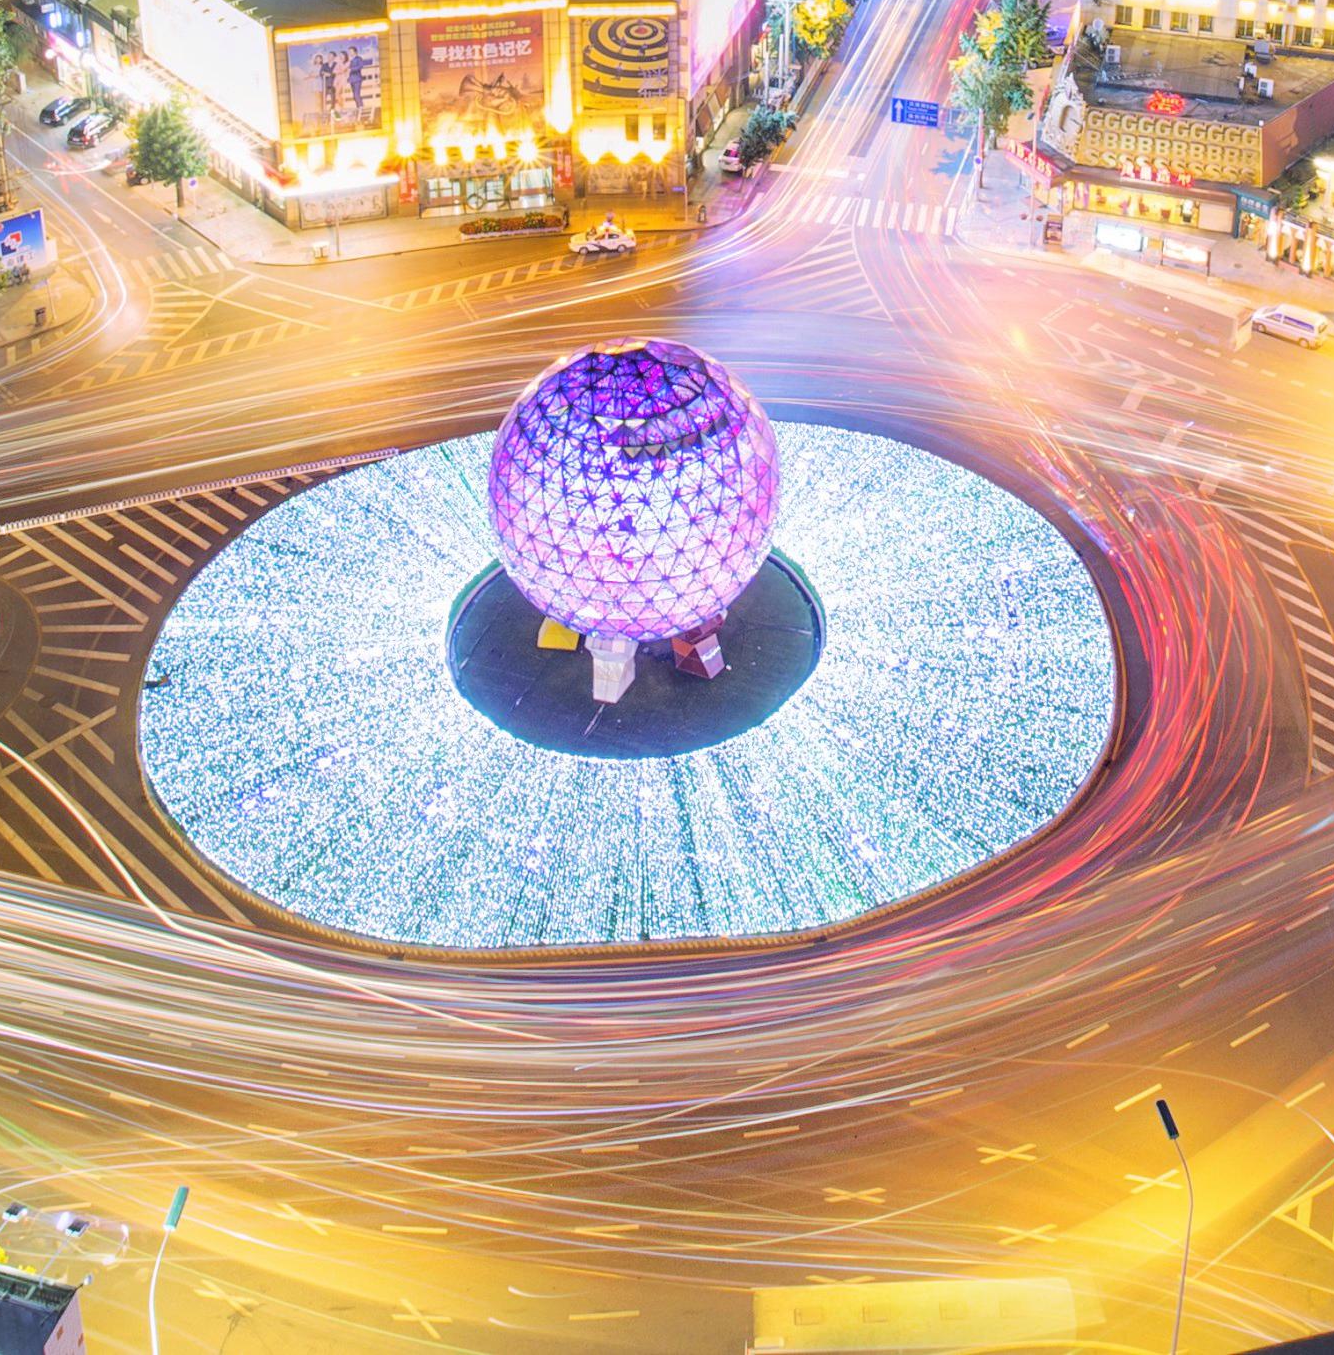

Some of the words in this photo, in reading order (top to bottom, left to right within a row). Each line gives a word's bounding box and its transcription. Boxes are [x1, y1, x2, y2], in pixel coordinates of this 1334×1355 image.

[430, 39, 533, 63] 寻找红色记忆
